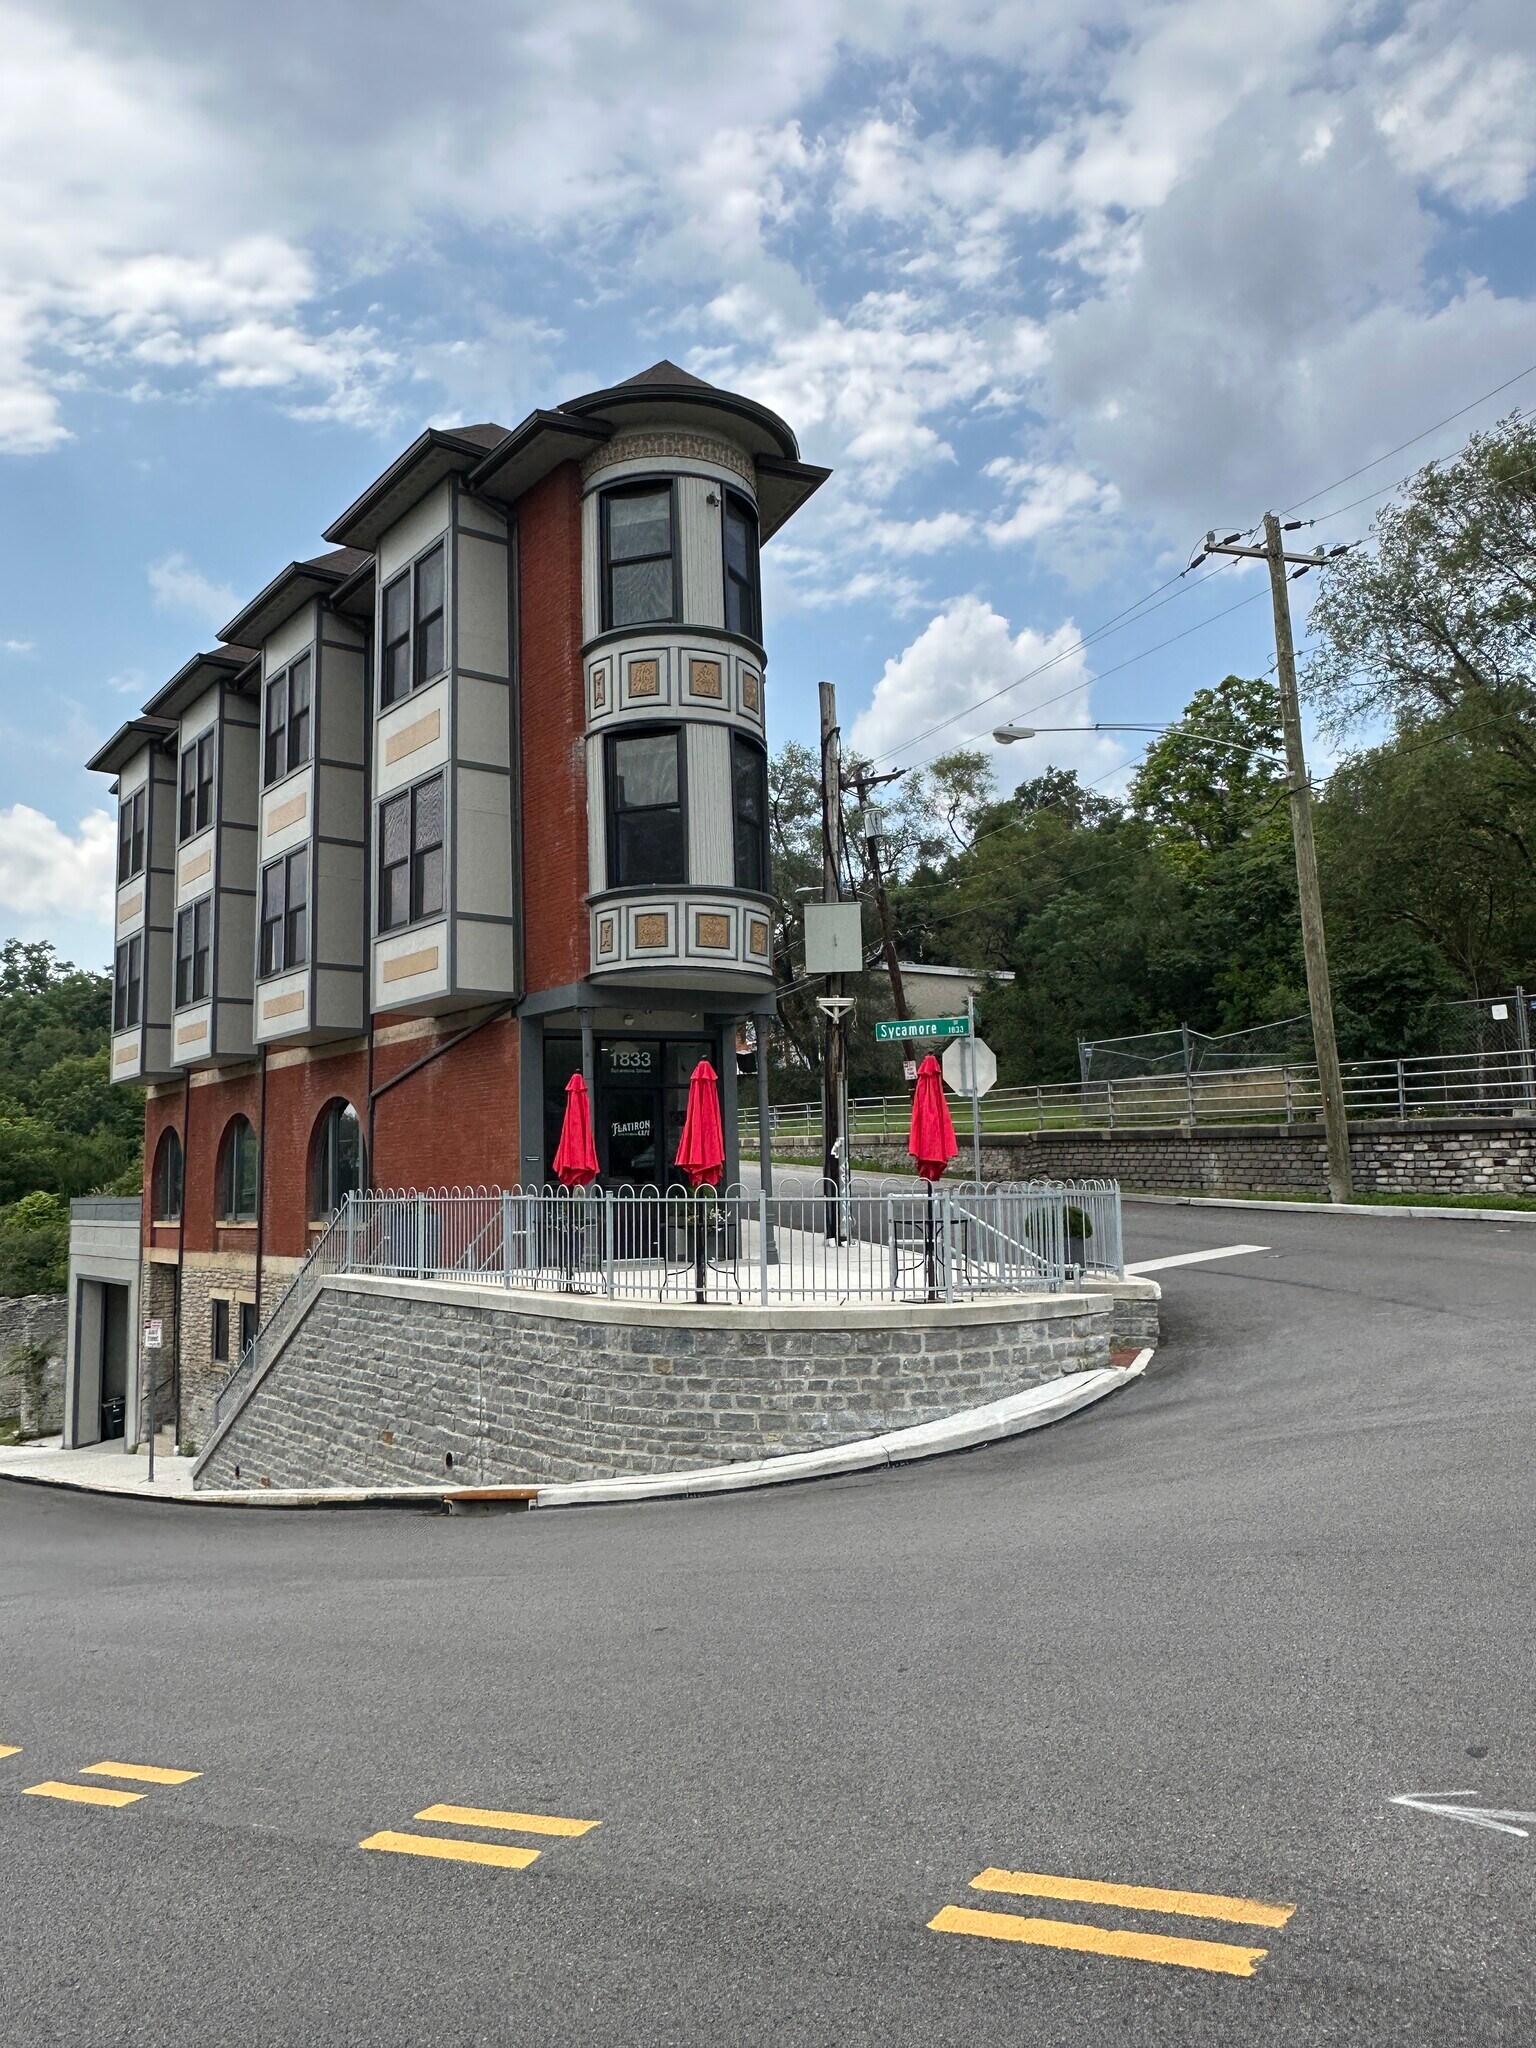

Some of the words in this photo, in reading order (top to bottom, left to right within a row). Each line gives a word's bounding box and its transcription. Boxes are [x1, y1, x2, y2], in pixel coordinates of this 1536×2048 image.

[881, 1024, 937, 1039] Sycamore
[610, 1051, 651, 1067] 1833
[611, 1119, 651, 1137] FLATIRON
